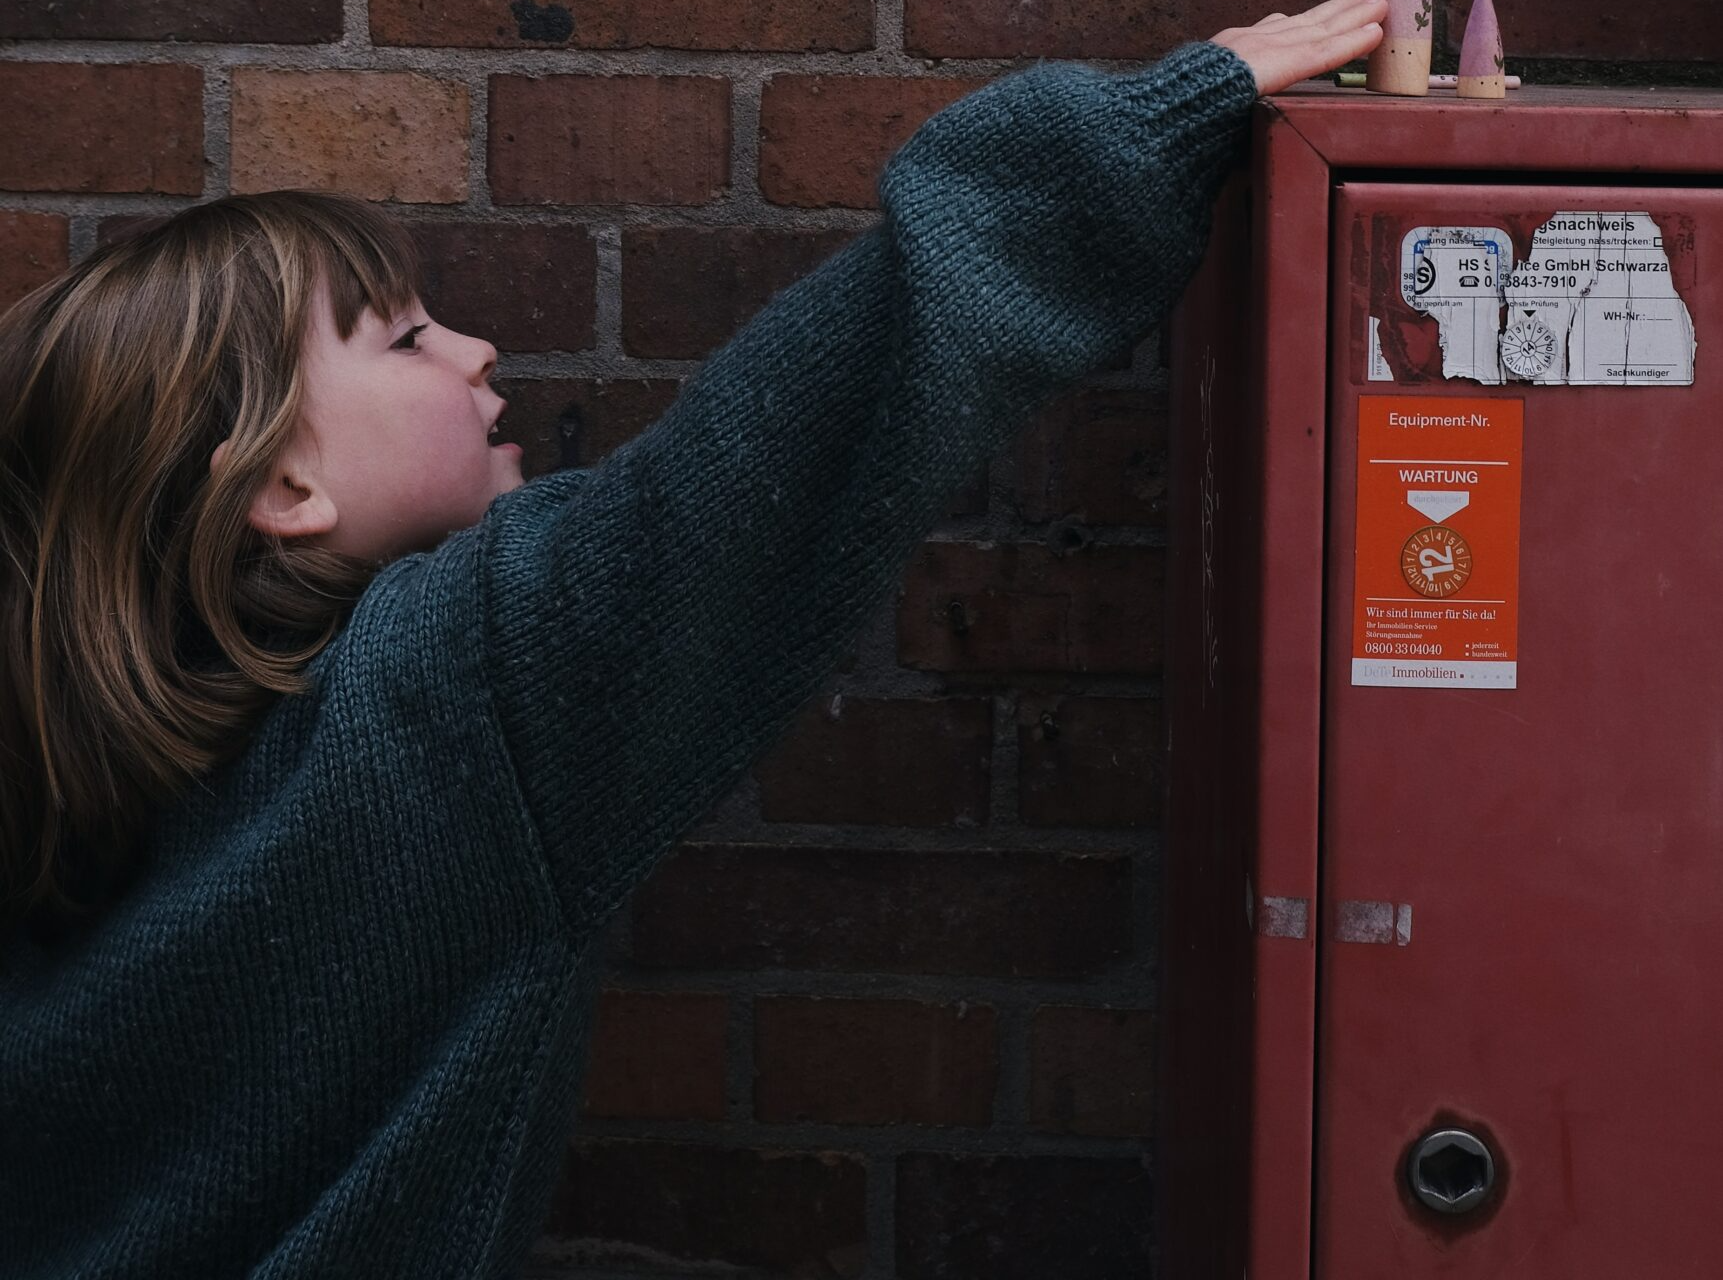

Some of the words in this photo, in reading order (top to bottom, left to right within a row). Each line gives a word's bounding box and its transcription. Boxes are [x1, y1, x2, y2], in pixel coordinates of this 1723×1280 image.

[1533, 236, 1586, 247] Steigleitung
[1459, 259, 1479, 271] HS
[1544, 260, 1590, 272] GmbH
[1531, 300, 1559, 309] Prüfung
[1537, 326, 1543, 334] 5
[1523, 342, 1535, 355] 14
[1606, 368, 1671, 378] Sachkundiger
[1389, 412, 1491, 428] Equipment-Nr.
[1399, 470, 1478, 484] WARTUNG
[1422, 534, 1430, 543] 3
[1436, 532, 1441, 540] 4
[1448, 536, 1455, 545] 5
[1411, 543, 1420, 552] 2
[1455, 547, 1465, 555] 6
[1419, 545, 1455, 582] 12
[1407, 567, 1419, 578] 12
[1453, 573, 1462, 581] 8
[1415, 577, 1426, 588] 11
[1444, 581, 1451, 590] 9
[1428, 583, 1439, 592] 10
[1366, 607, 1385, 618] Wir
[1387, 607, 1408, 619] sind
[1410, 608, 1443, 619] immer
[1445, 608, 1460, 619] für
[1462, 609, 1478, 620] Sie
[1480, 610, 1496, 620] da!
[1365, 631, 1423, 639] Störungsannahme
[1365, 642, 1393, 654] 0800
[1395, 643, 1408, 654] 33
[1409, 644, 1442, 655] 04040
[1471, 642, 1500, 650] jederzeit
[1471, 650, 1508, 658] bundesweit
